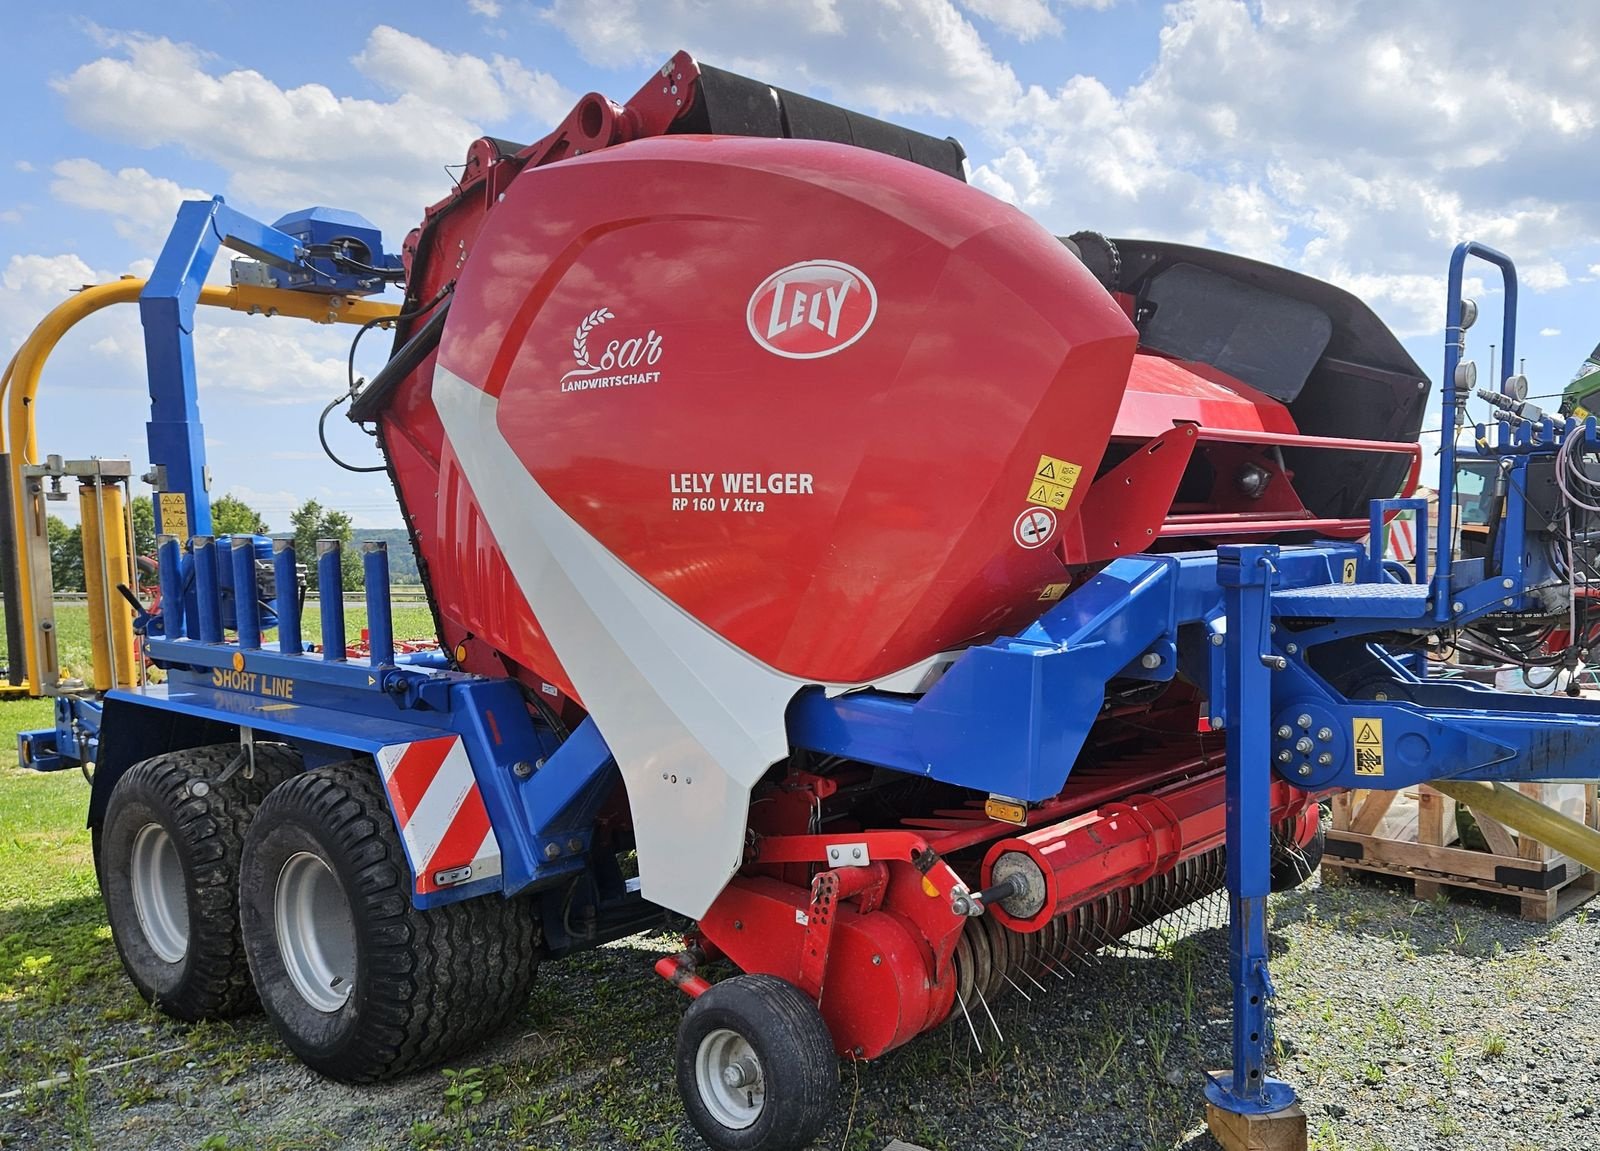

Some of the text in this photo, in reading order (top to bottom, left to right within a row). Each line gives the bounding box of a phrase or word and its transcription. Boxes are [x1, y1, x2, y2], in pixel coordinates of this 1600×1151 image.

[767, 279, 853, 339] LELY
[561, 372, 661, 393] LANDWIRTSCHAFT
[670, 473, 814, 495] LELY WELGER
[672, 498, 765, 513] RP 160 V Xtra
[212, 667, 294, 699] SHORT LINE
